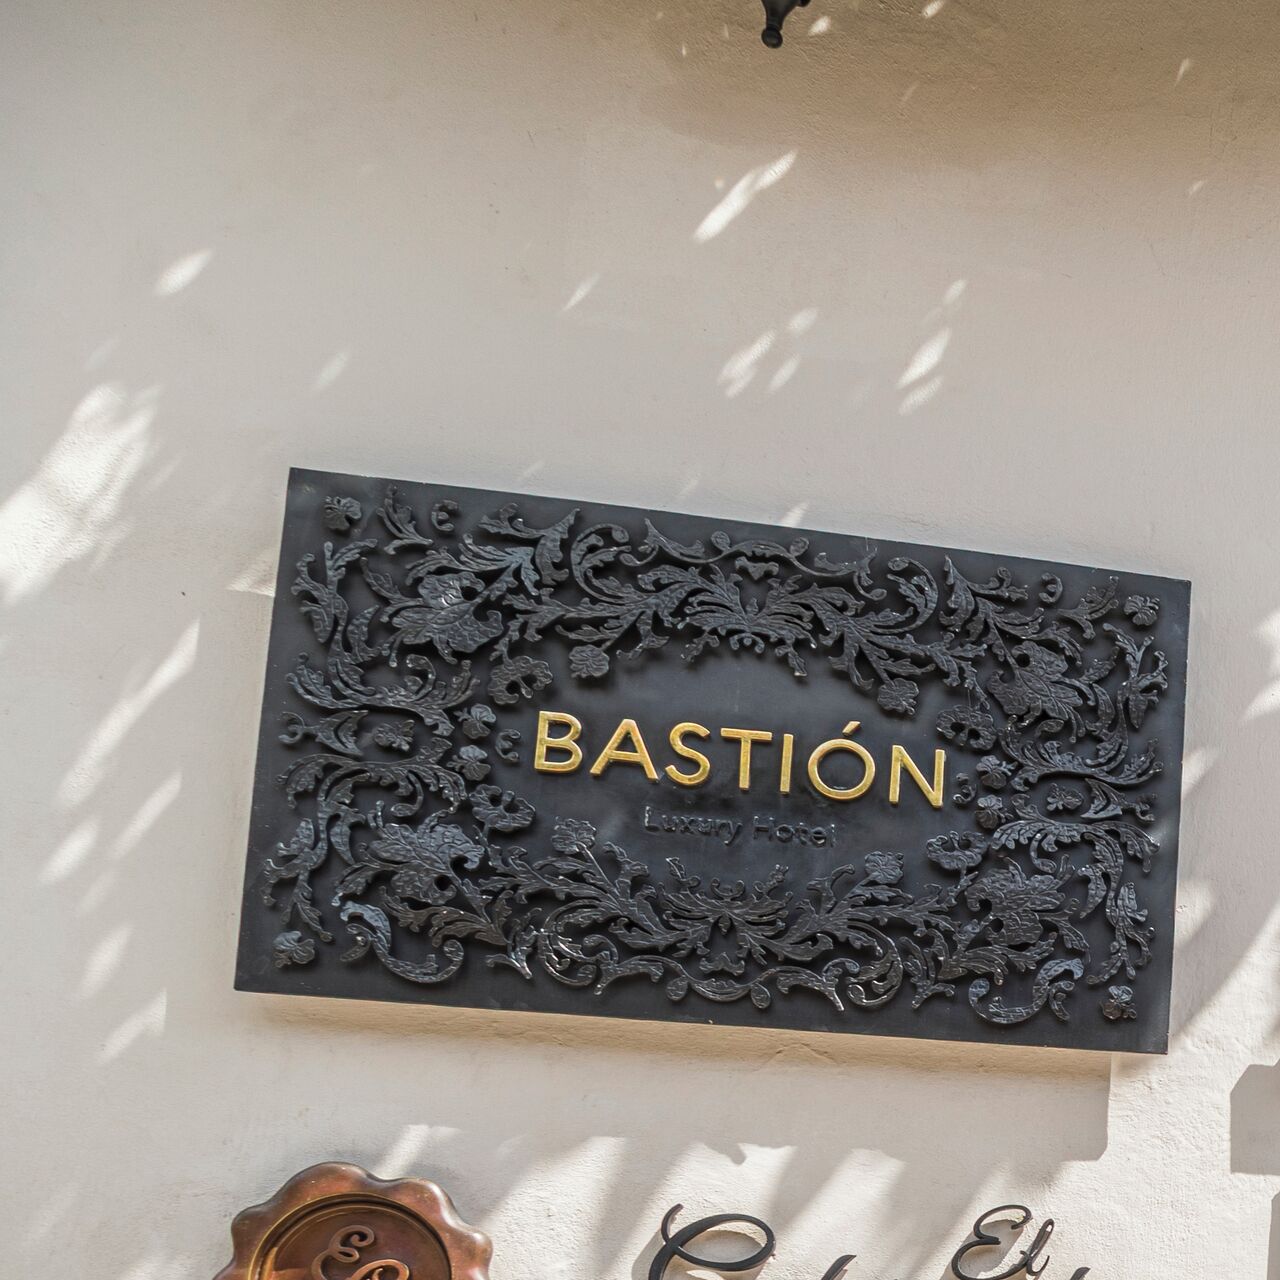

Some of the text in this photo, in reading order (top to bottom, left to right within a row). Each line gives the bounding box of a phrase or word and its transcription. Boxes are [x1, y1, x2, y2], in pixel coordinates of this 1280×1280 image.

[534, 710, 946, 808] BASTIÓN
[644, 806, 837, 849] Luxury Hotel
